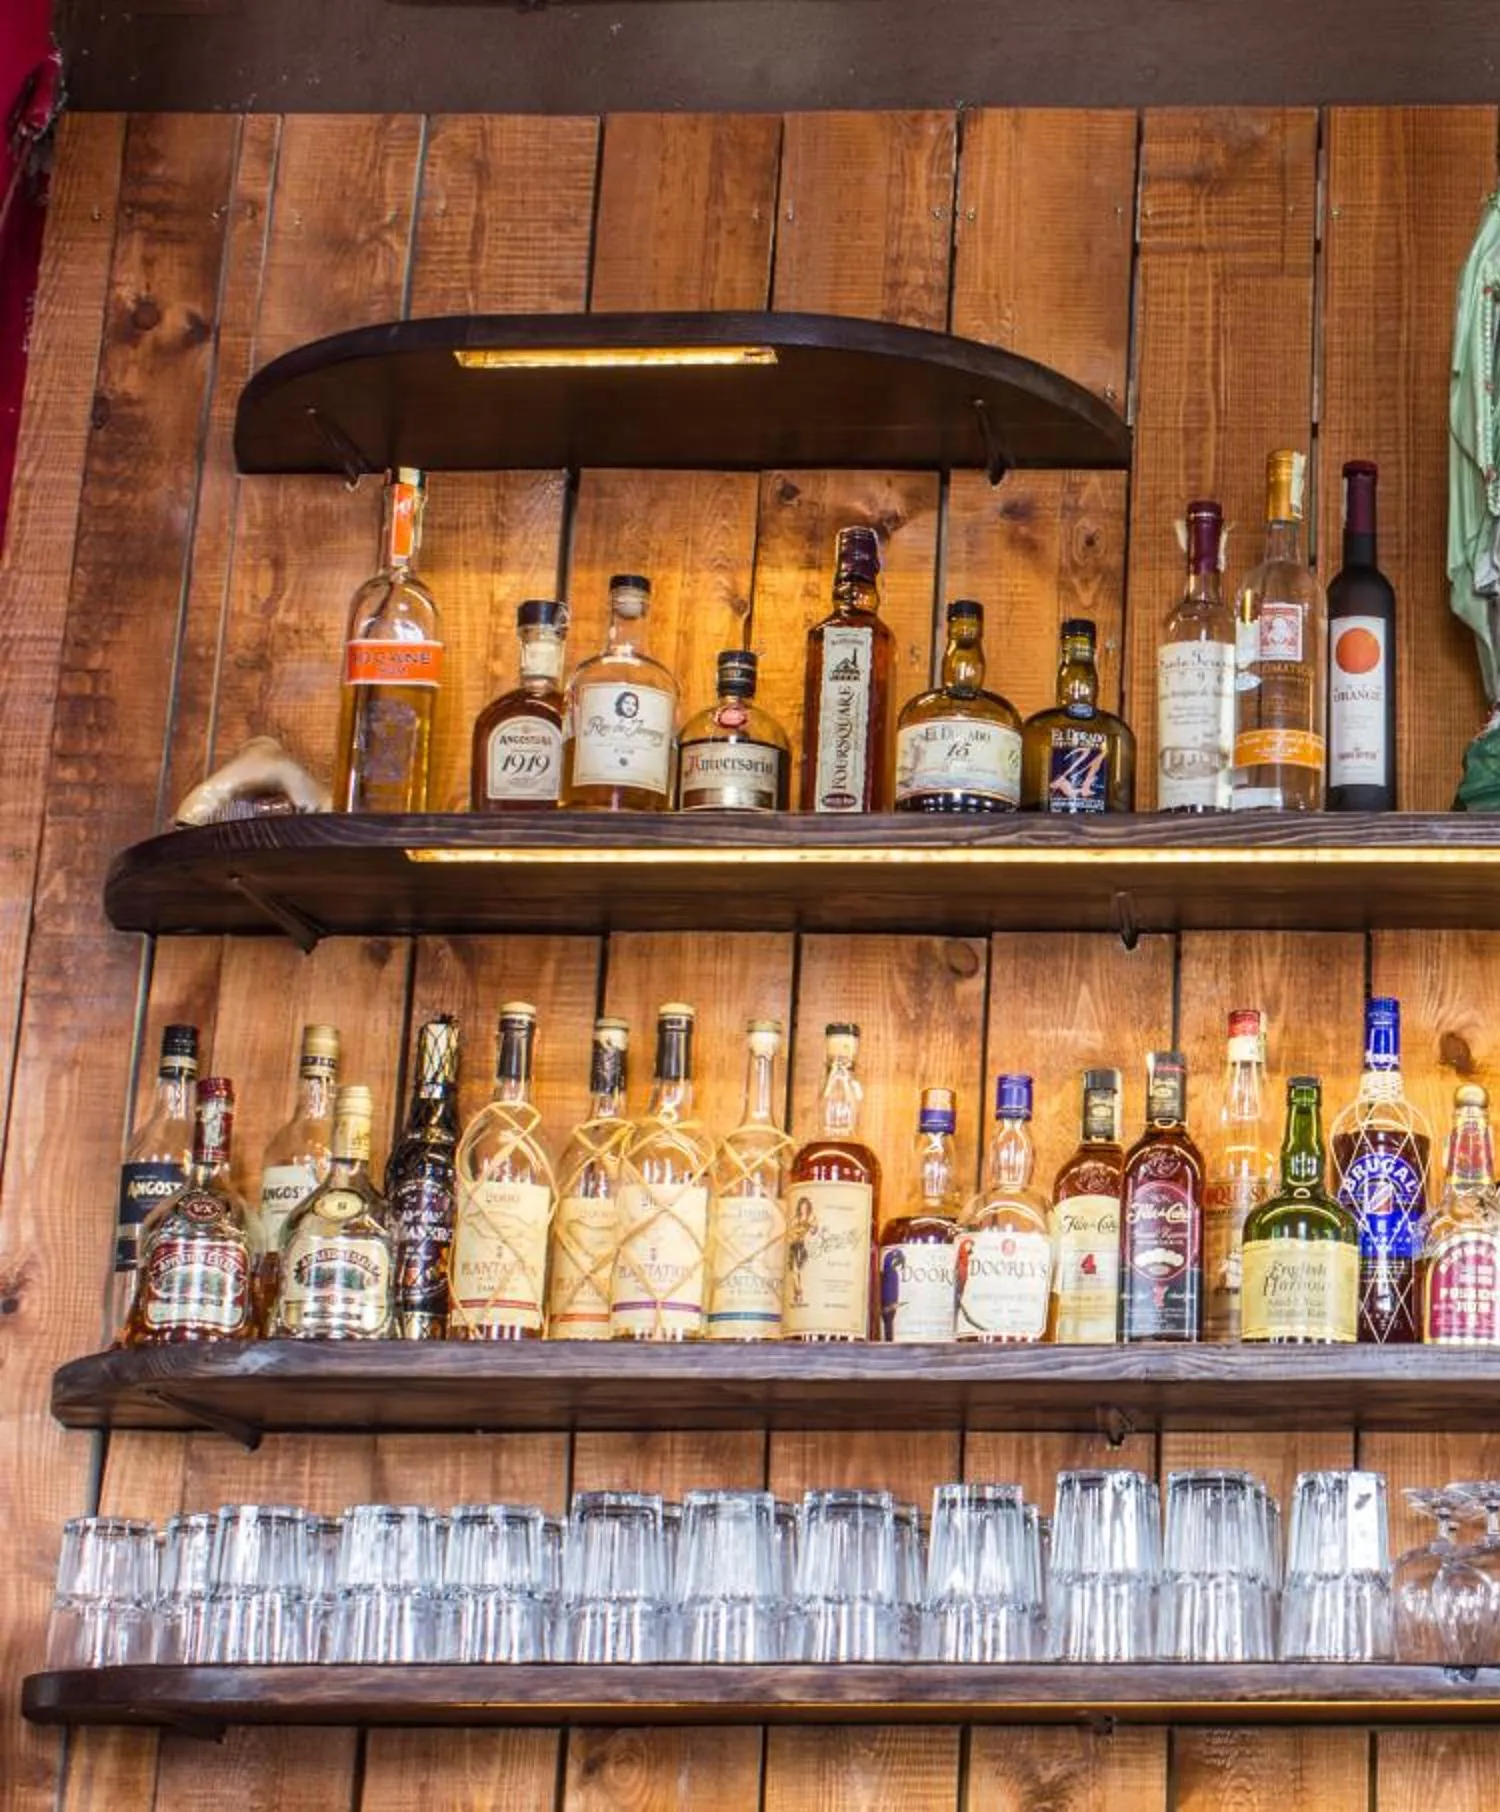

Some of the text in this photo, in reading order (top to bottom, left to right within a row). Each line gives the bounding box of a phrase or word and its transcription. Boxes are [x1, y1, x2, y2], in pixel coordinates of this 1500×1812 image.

[832, 685, 852, 790] FOURSQUARE
[500, 753, 551, 775] 1919
[684, 754, 774, 778] Aniversario
[1346, 1152, 1420, 1194] BRUGAL
[128, 1179, 181, 1199] ANGOST
[1081, 1254, 1096, 1275] 4
[1271, 1261, 1327, 1278] English
